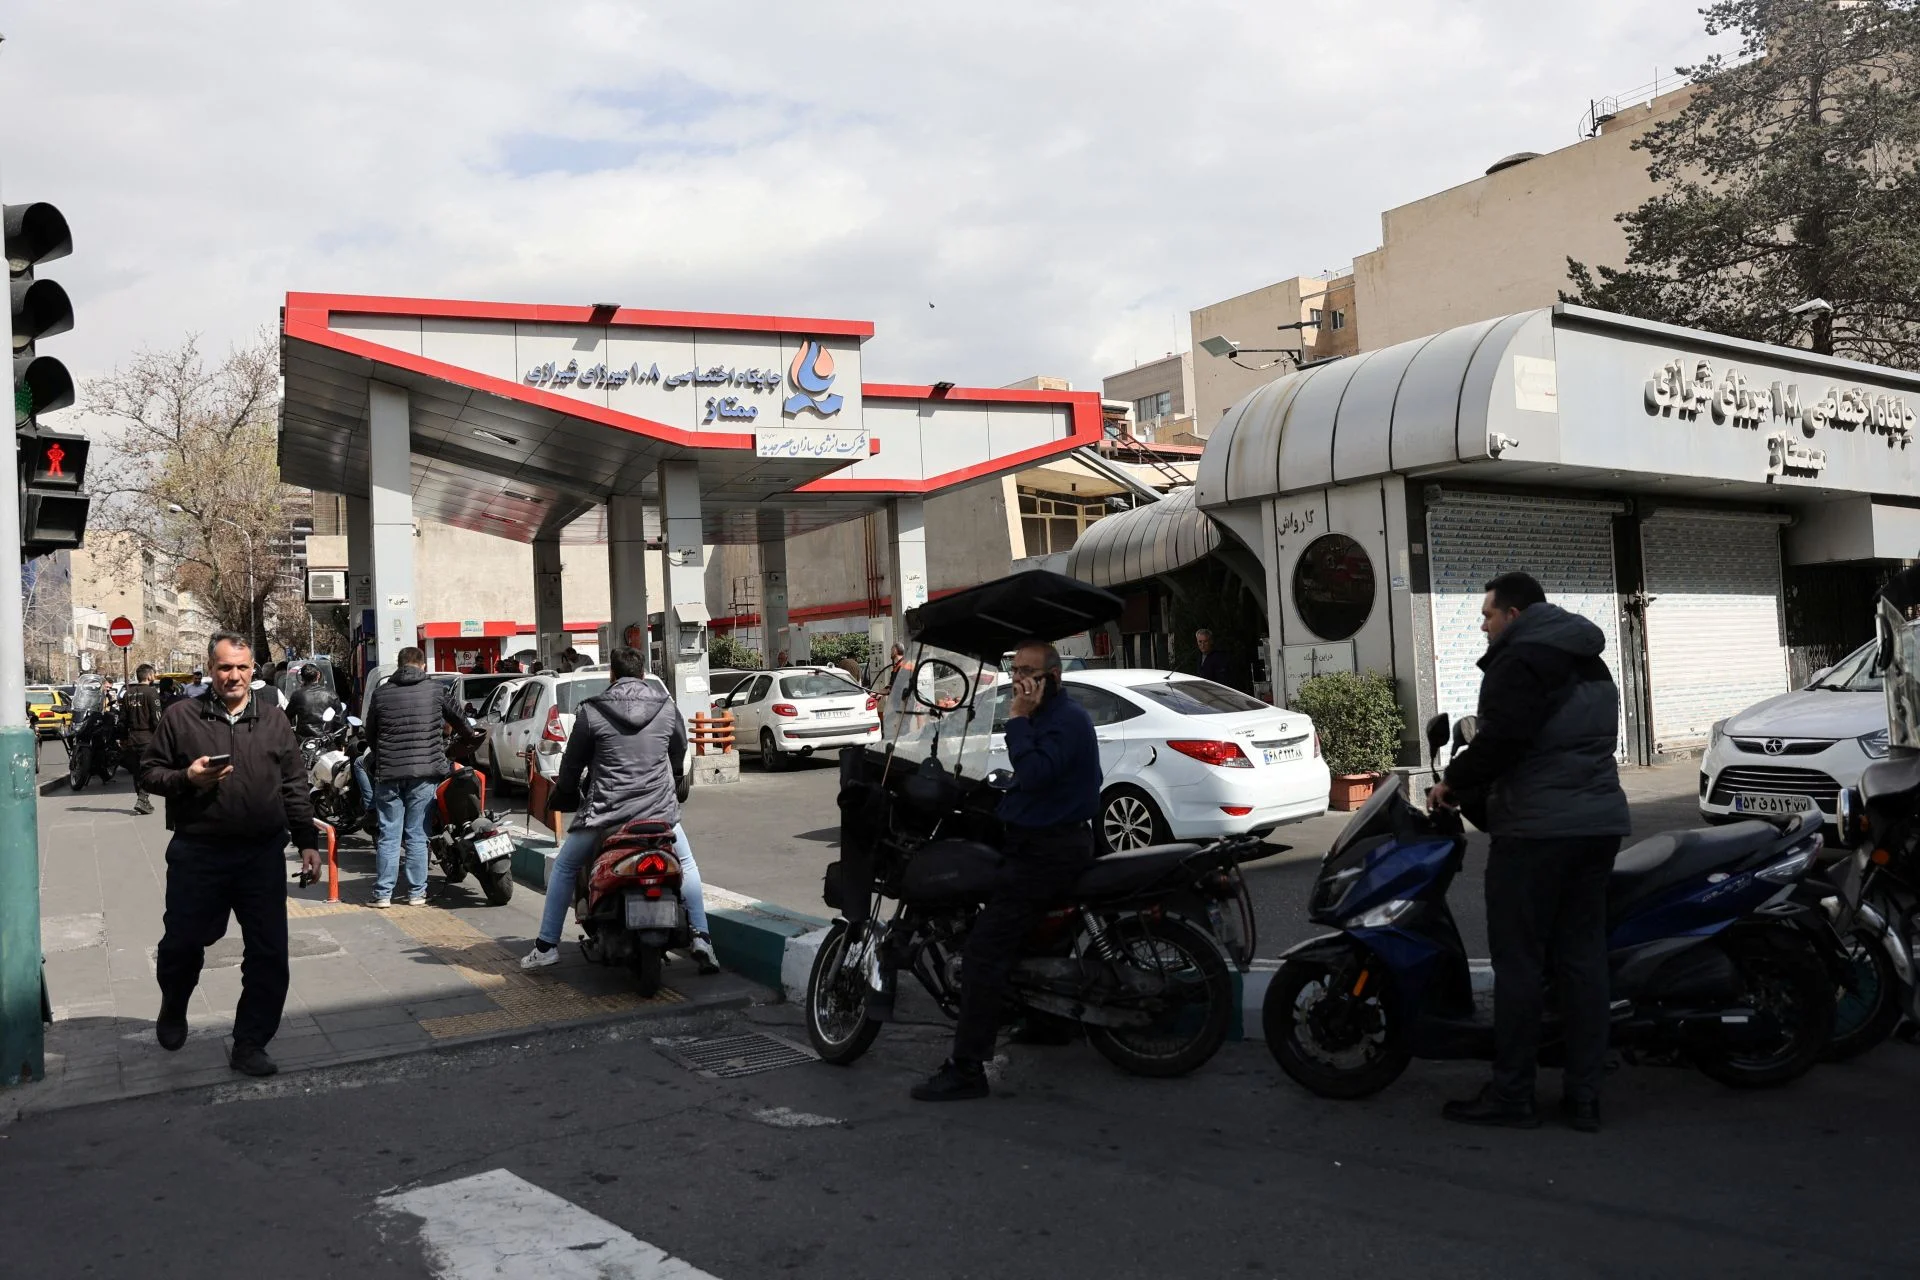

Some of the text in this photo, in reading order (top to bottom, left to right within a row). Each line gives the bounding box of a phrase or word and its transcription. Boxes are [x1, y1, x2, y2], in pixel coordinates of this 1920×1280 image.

[524, 357, 782, 390] جایگاه اختصاصی ۱۰۸ میرزای شیرازی
[1644, 358, 1714, 421] شیرازی
[704, 396, 759, 421] ممتاز
[1802, 385, 1874, 434] اختصاصی
[760, 430, 867, 456] شرکت انرژی سازان عصر جدید
[1767, 430, 1827, 476] ممتاز
